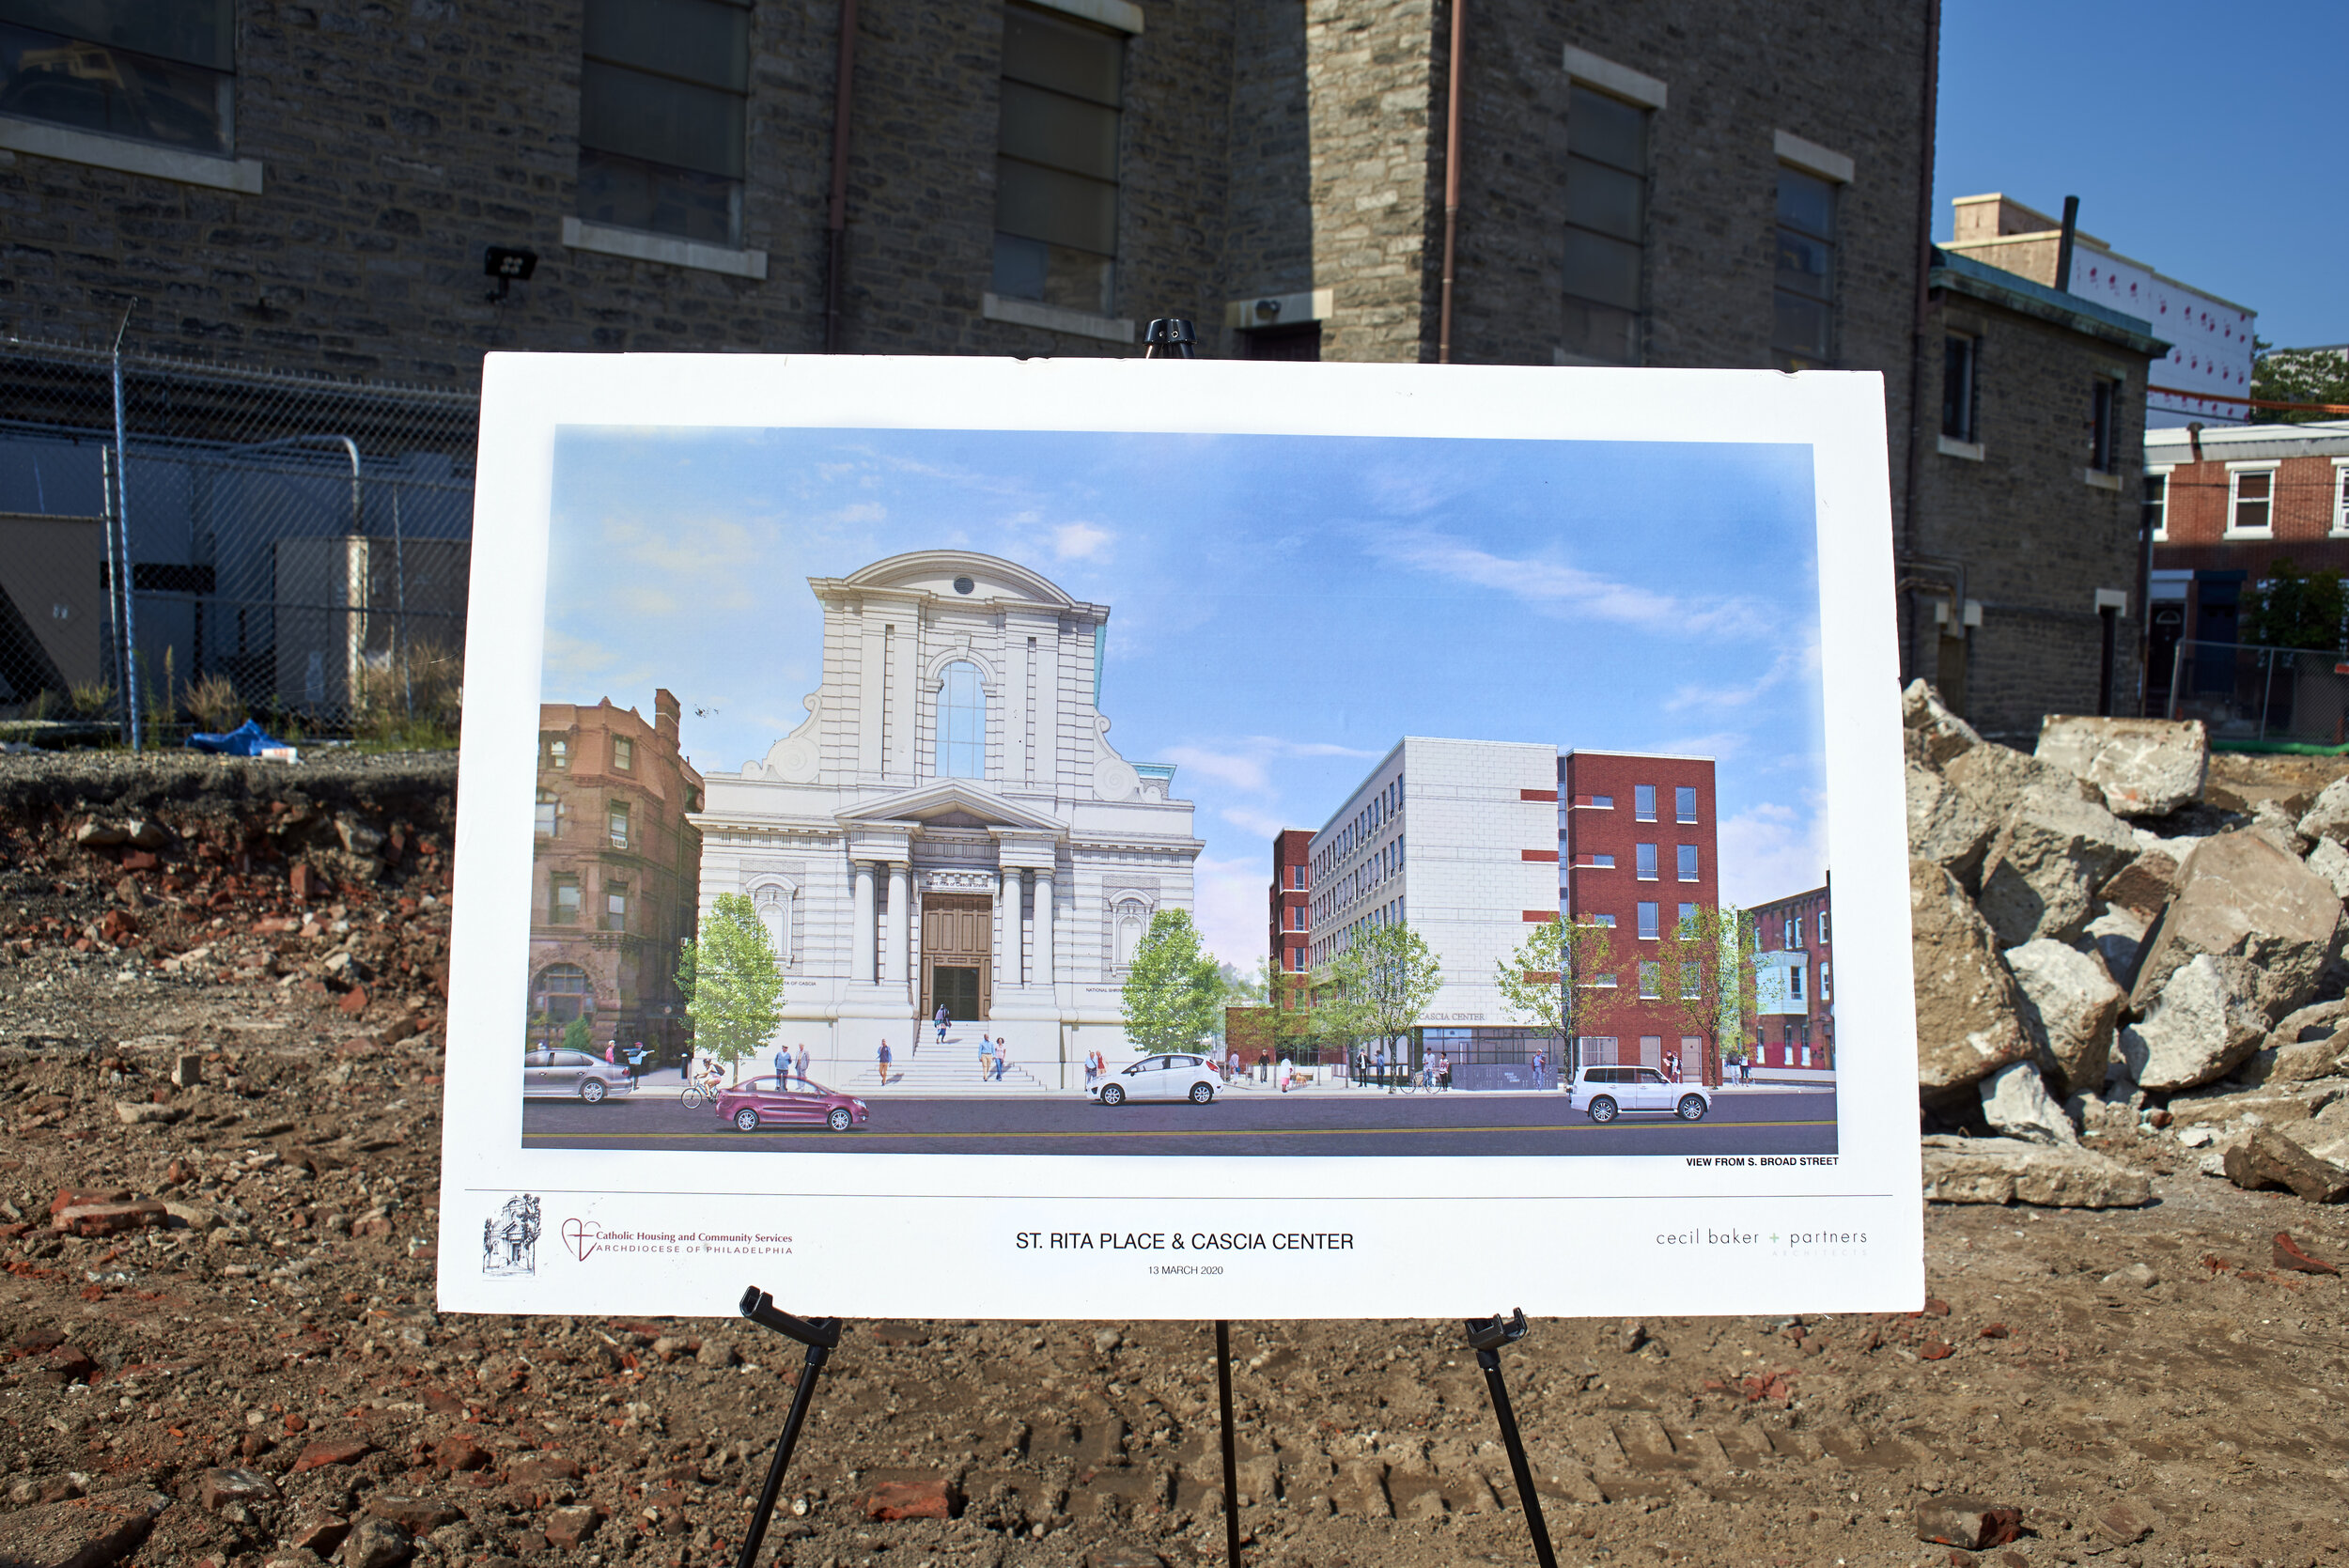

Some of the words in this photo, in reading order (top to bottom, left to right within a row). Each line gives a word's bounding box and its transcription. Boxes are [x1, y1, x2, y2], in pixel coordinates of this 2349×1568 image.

[1419, 1013, 1450, 1021] CASCIA
[1452, 1013, 1486, 1021] CENTER
[1686, 1157, 1712, 1167] VIEW
[1715, 1157, 1745, 1167] FROM
[1748, 1157, 1757, 1166] S.
[1760, 1157, 1797, 1166] BROAD
[1799, 1157, 1839, 1166] STREET
[596, 1231, 634, 1240] Catholic
[637, 1232, 676, 1244] Housing
[677, 1233, 695, 1241] and
[698, 1233, 753, 1245] Community
[754, 1234, 793, 1243] Services
[1016, 1232, 1043, 1250] ST.
[1050, 1233, 1094, 1250] RITA
[1100, 1233, 1165, 1250] PLACE
[1172, 1233, 1185, 1250] &
[1191, 1233, 1267, 1250] CASCIA
[1272, 1233, 1354, 1250] CENTER
[1656, 1228, 1699, 1245] cecil
[1708, 1228, 1759, 1245] baker
[1790, 1231, 1868, 1248] partners
[596, 1245, 680, 1253] ARCHDIOCESE
[706, 1246, 793, 1254] PHILADELPHIA
[1148, 1266, 1159, 1275] 13
[1161, 1265, 1198, 1275] MARCH
[1201, 1265, 1224, 1275] 2020
